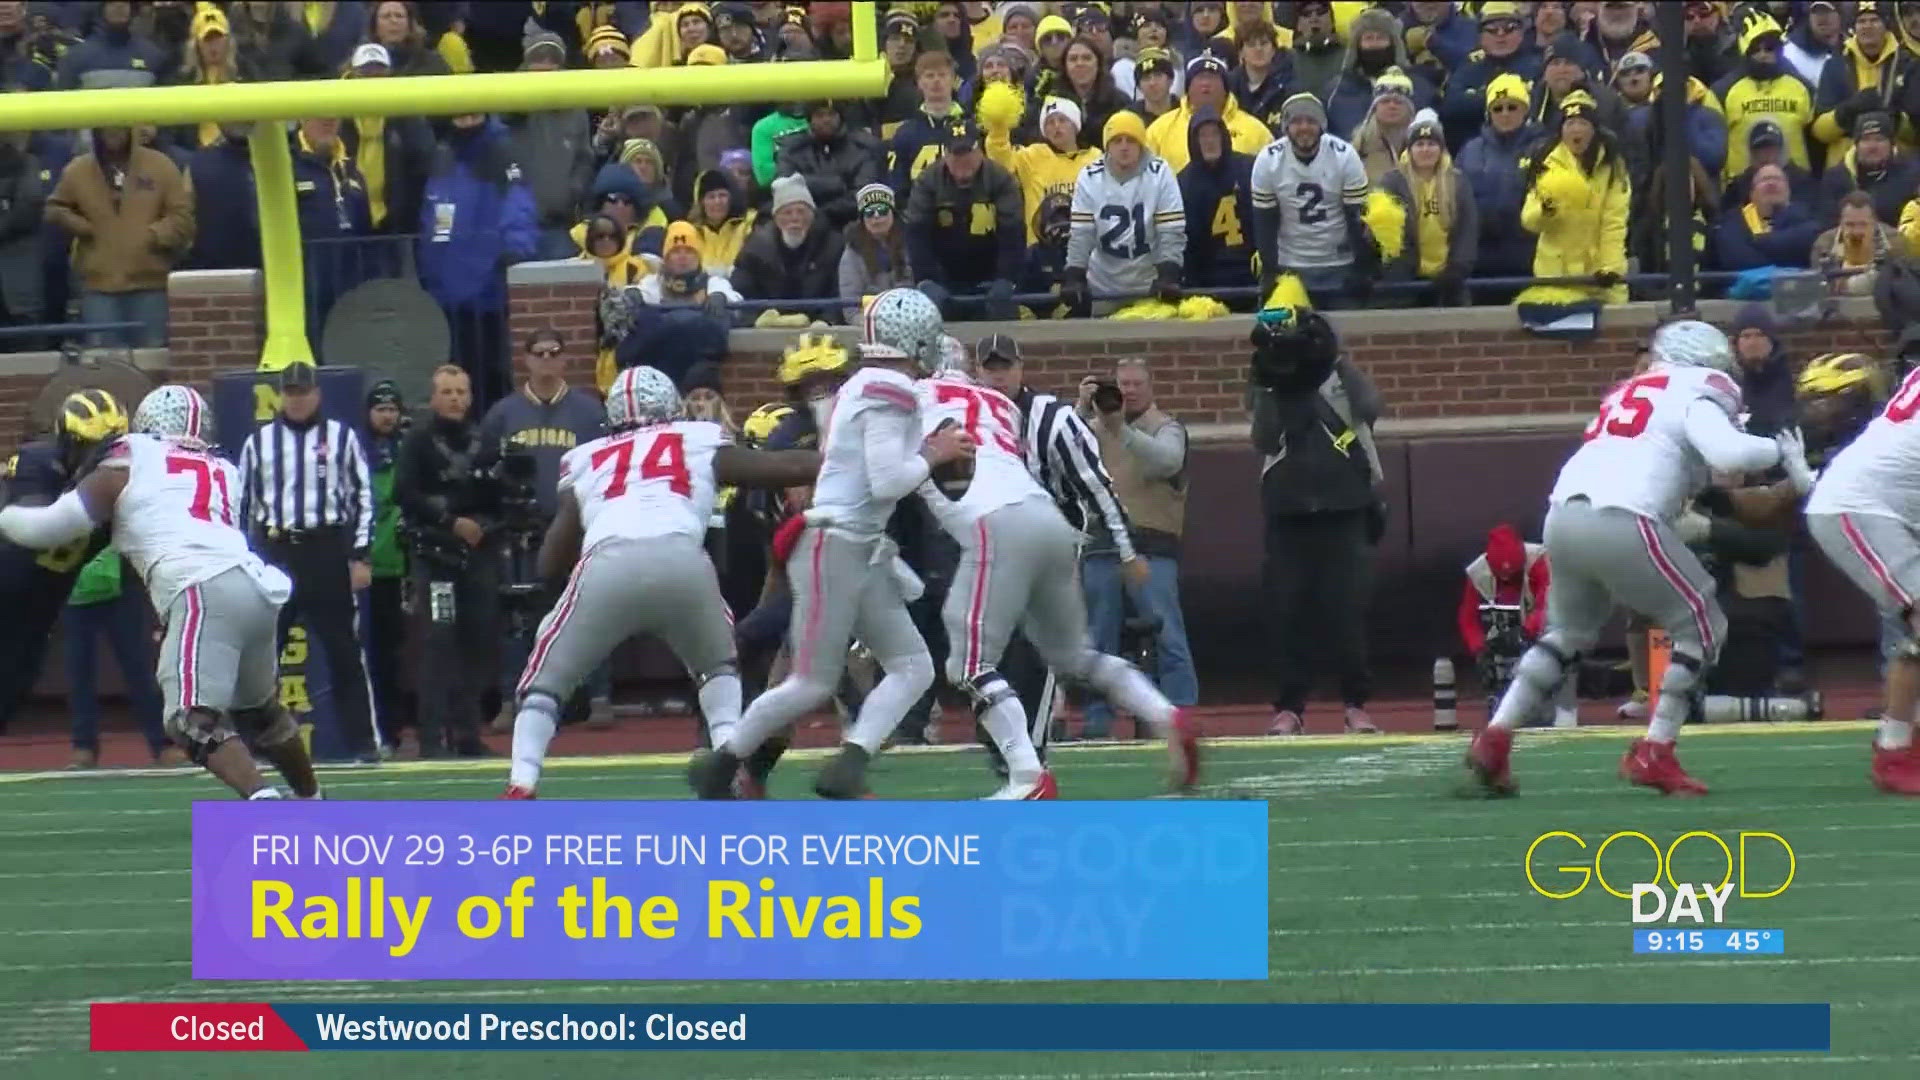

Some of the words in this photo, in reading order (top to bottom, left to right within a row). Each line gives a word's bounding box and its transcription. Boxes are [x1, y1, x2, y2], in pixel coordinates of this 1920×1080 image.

[1741, 99, 1798, 113] MICHIGAN
[1099, 202, 1151, 259] 21
[1212, 196, 1243, 247] 4
[1296, 182, 1328, 225] 2
[166, 456, 234, 526] 71
[591, 432, 691, 500] 74
